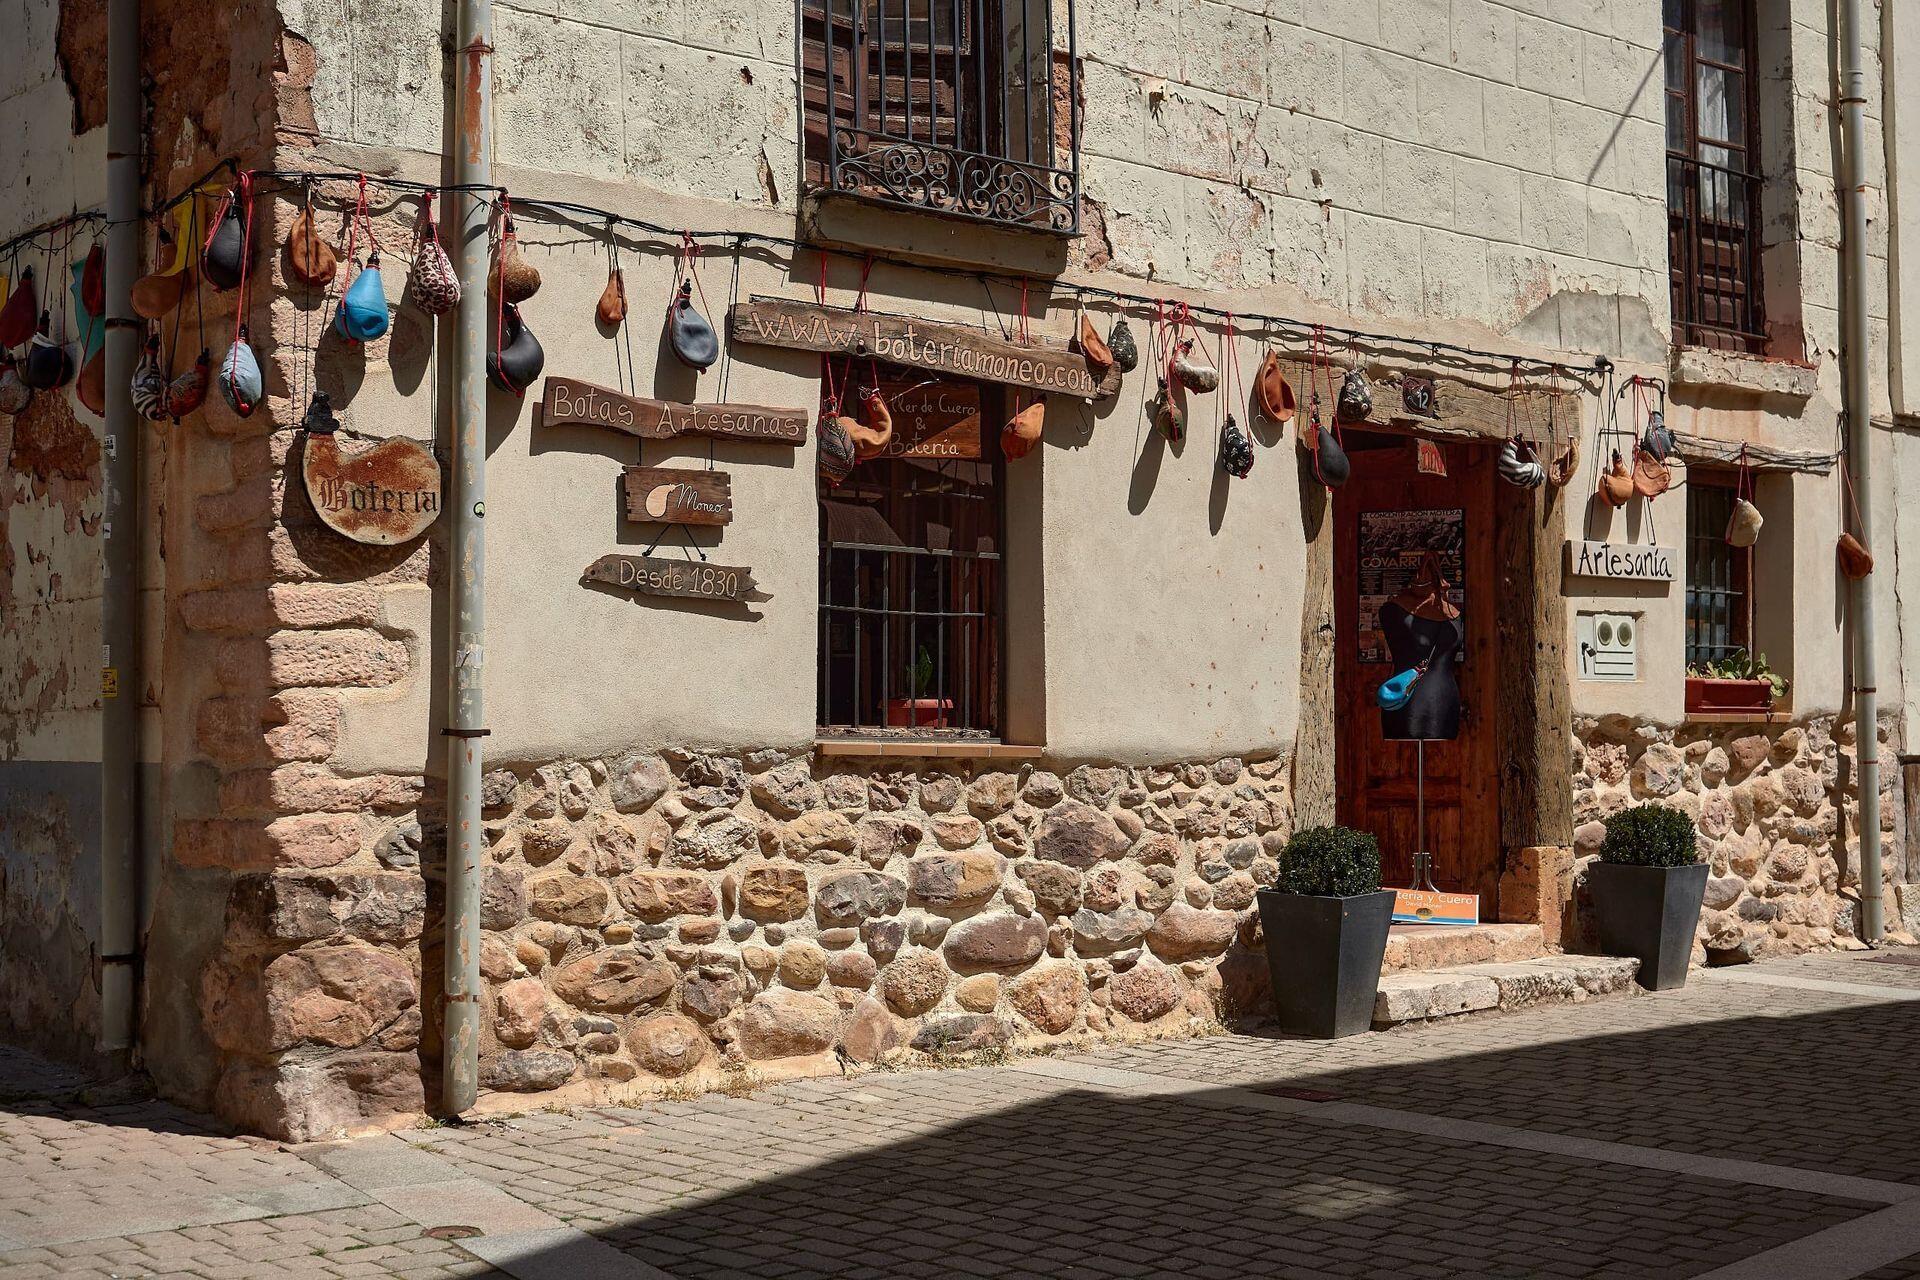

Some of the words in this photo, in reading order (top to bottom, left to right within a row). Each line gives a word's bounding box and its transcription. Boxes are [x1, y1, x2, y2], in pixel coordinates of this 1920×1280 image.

[552, 384, 635, 425] Botas
[656, 403, 801, 437] Artesanas
[920, 393, 936, 413] de
[938, 393, 976, 415] Cuero
[915, 416, 927, 430] &
[676, 482, 726, 513] Moneo
[1578, 542, 1672, 578] Artesanía
[619, 559, 683, 590] Desde
[690, 567, 738, 598] 1830
[1427, 895, 1434, 903] y
[1438, 894, 1473, 905] Cuero
